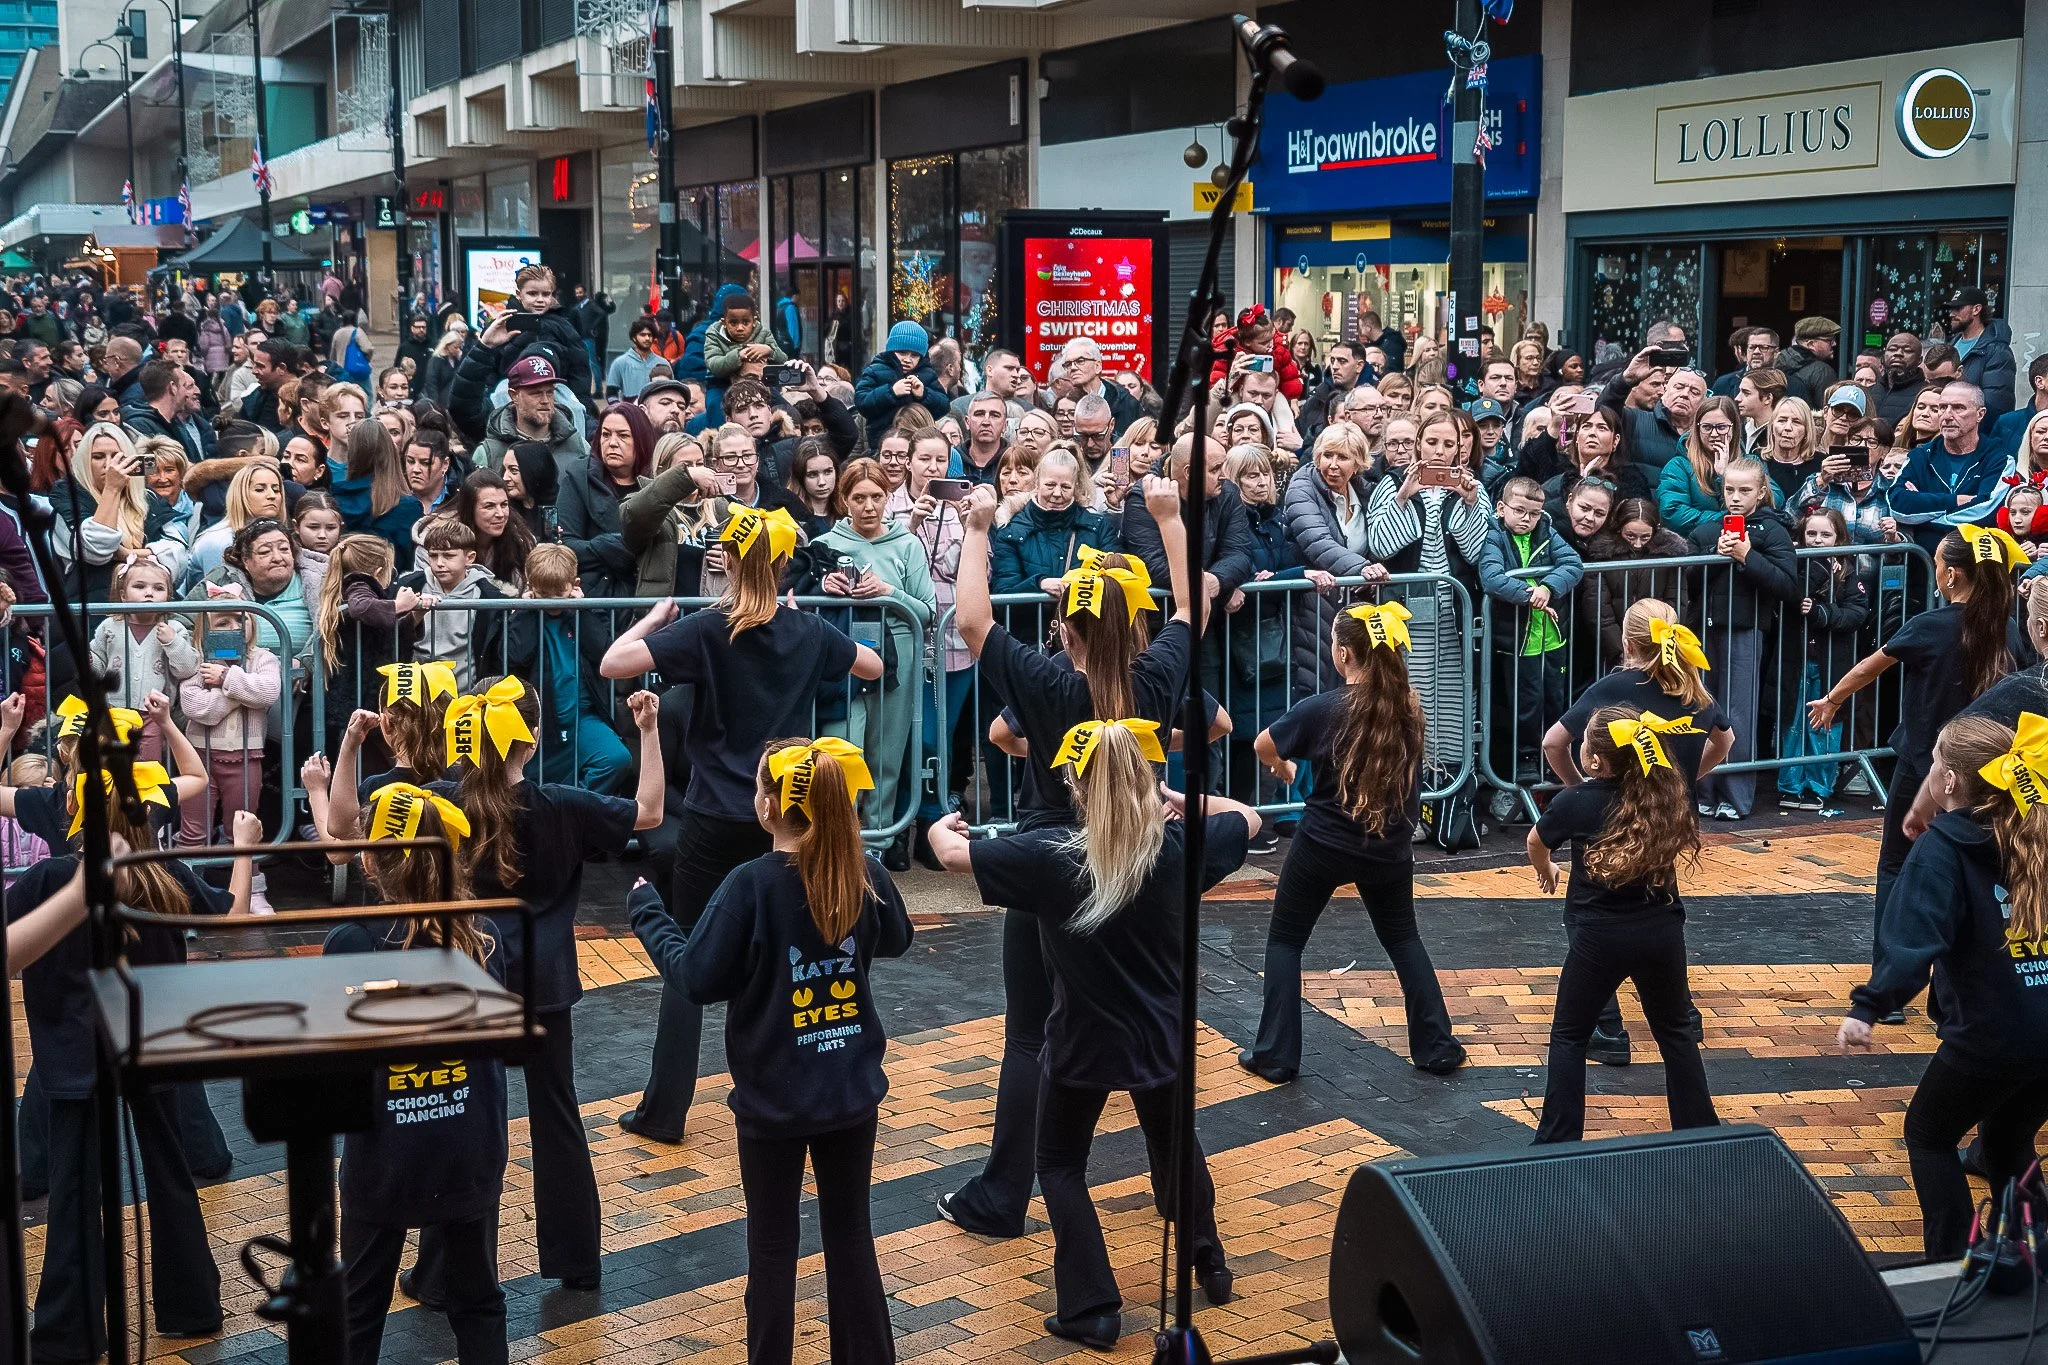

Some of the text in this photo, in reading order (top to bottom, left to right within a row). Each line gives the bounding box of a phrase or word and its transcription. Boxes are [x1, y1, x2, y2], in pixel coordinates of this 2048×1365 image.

[1914, 107, 1971, 119] LOLLIUS
[1678, 104, 1852, 164] LOLLIUS
[1288, 129, 1313, 165] H&T
[1069, 228, 1103, 236] JCDecaux
[1037, 300, 1141, 316] CHRISTMAS
[1039, 321, 1138, 336] SWITCH ON
[1040, 343, 1067, 351] Satur
[731, 514, 758, 544] ELIZA
[1076, 575, 1096, 607] DOLL
[397, 664, 413, 696] RUBY
[1066, 729, 1093, 762] LACE
[789, 759, 813, 805] AMELIA
[385, 790, 413, 837] ALANNA
[792, 956, 856, 983] KATZ
[793, 1002, 859, 1028] EYES
[797, 1024, 862, 1046] PERFORMING
[817, 1038, 846, 1053] ARTS
[388, 1066, 468, 1091] EYES
[387, 1086, 470, 1111] SCHOOL OF
[396, 1102, 465, 1124] DANCING
